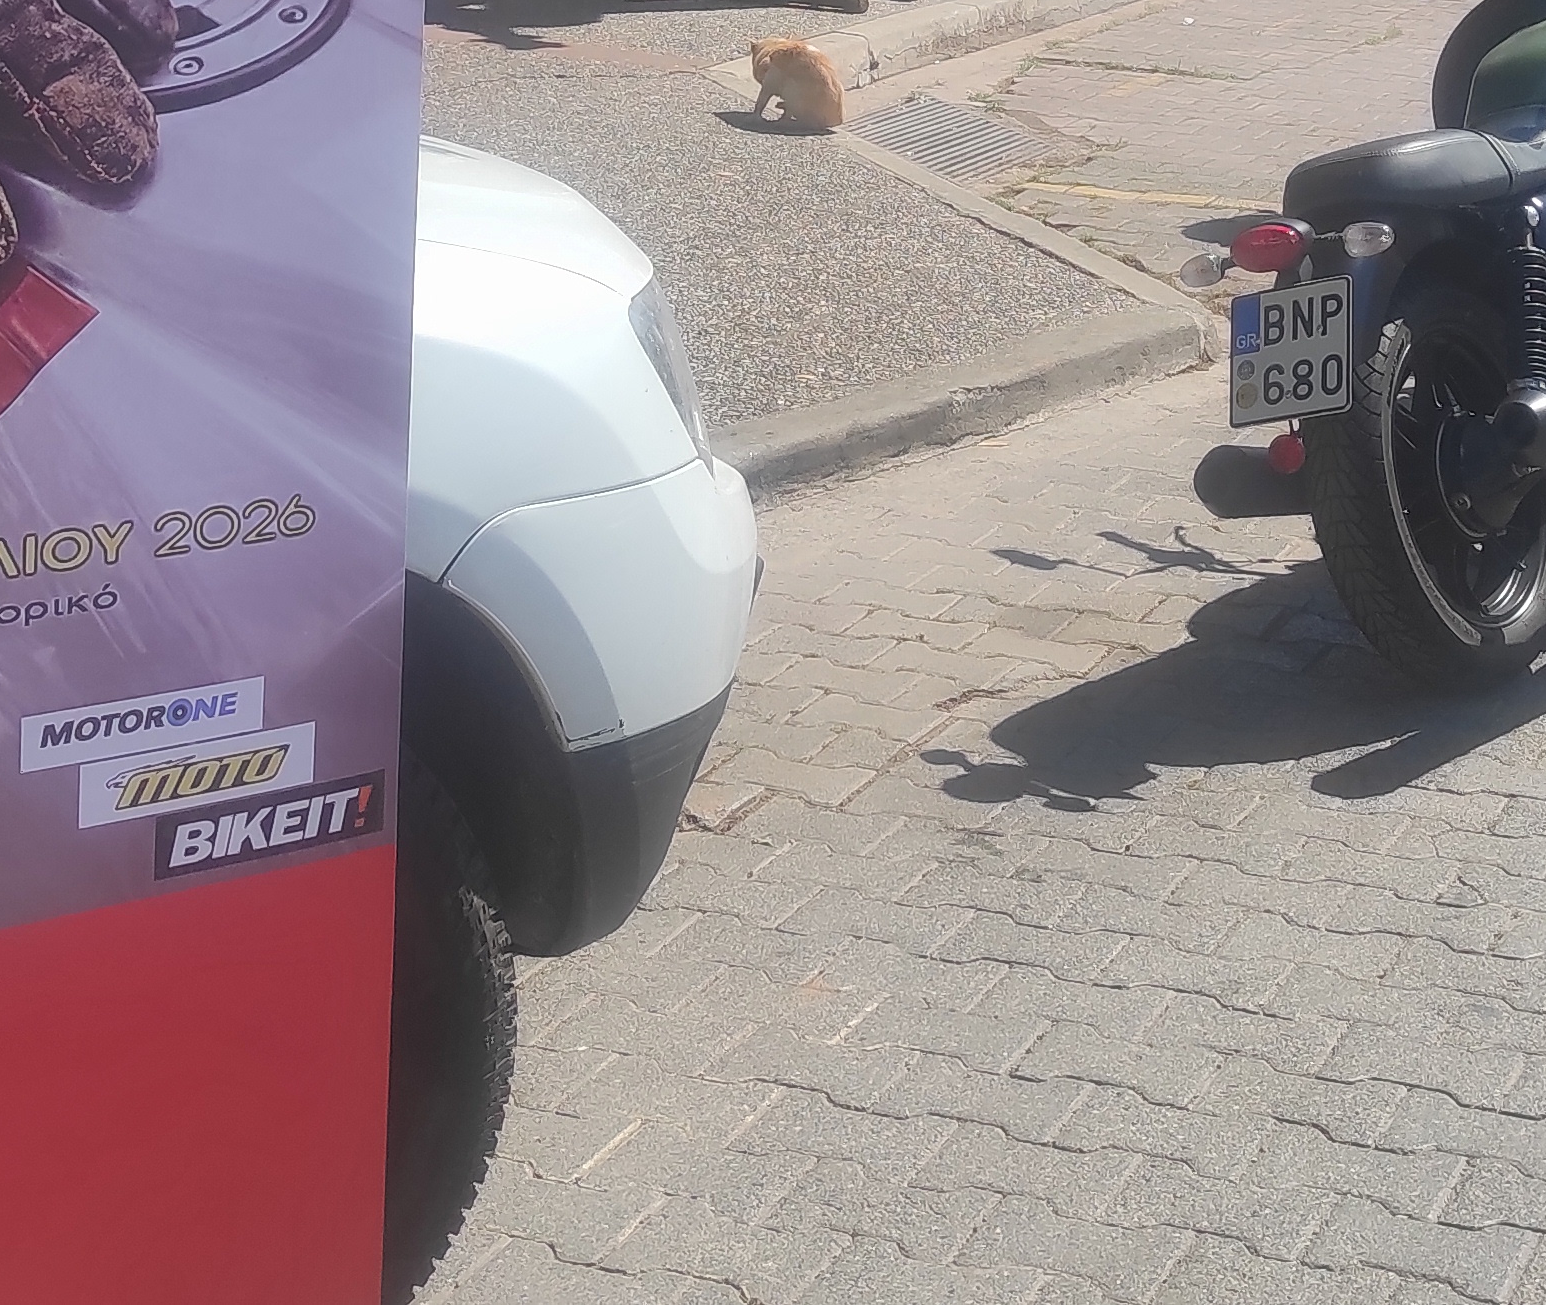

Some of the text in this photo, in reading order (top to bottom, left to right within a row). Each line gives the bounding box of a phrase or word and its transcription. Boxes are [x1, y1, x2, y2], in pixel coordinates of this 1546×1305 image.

[1236, 332, 1257, 349] GR
[1263, 293, 1344, 347] BNP
[1263, 353, 1344, 406] 680
[153, 493, 317, 558] 2026
[40, 691, 239, 749] MOTORONE
[114, 743, 291, 812] MOTO
[168, 785, 373, 869] BIKEIT!
